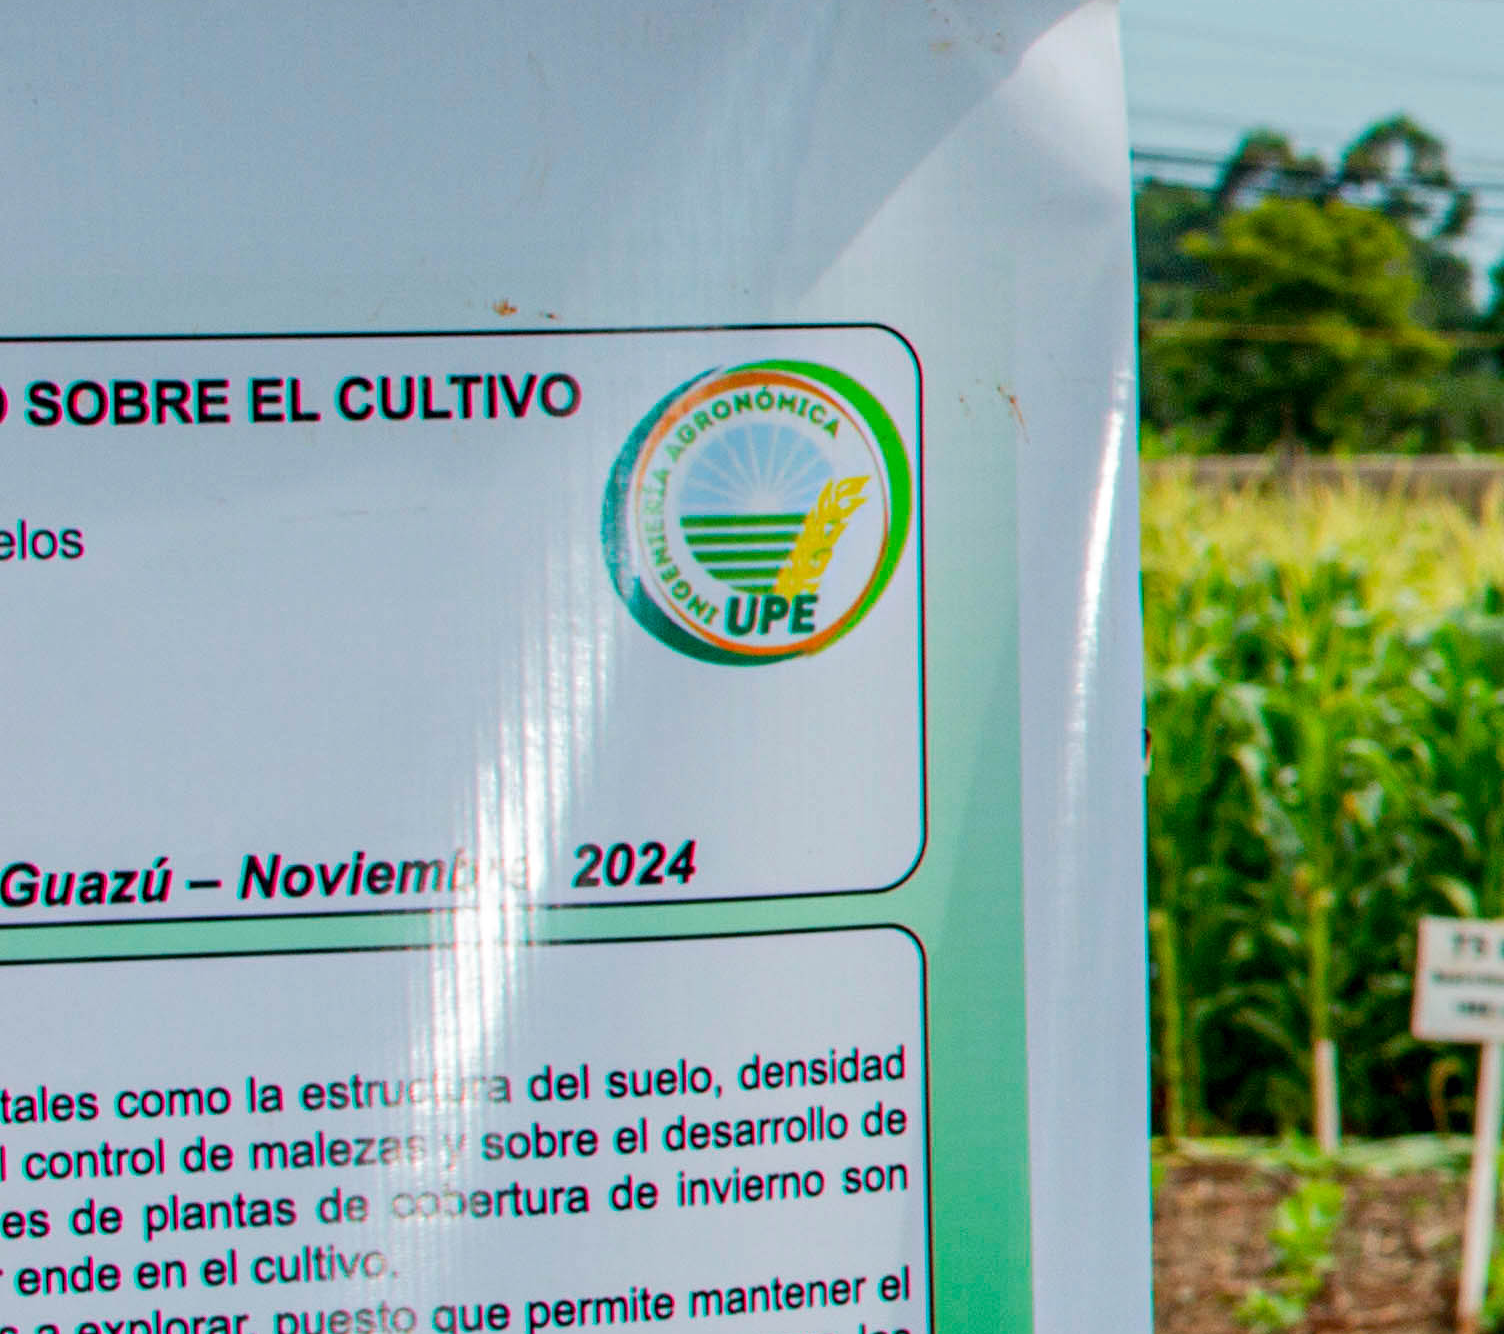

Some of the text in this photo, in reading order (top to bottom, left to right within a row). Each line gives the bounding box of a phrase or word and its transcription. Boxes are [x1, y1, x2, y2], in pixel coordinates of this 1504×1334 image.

[24, 379, 230, 427] SOBRE
[248, 377, 321, 424] EL
[334, 372, 581, 421] CULTIVO
[664, 386, 840, 463] AGRONÓMICA
[725, 593, 818, 636] UPE
[0, 856, 170, 907] Guazú
[570, 839, 696, 888] 2024
[114, 1085, 234, 1121] como
[245, 1076, 284, 1113] la
[527, 1063, 589, 1102] del
[605, 1059, 722, 1099] suelo,
[737, 1045, 904, 1091] densidad
[21, 1138, 165, 1182] control
[179, 1135, 234, 1174] de
[248, 1129, 427, 1171] malezas
[480, 1122, 598, 1161] sobre
[612, 1117, 648, 1155] el
[661, 1106, 848, 1152] desarrollo
[860, 1101, 906, 1138] de
[68, 1197, 123, 1237] de
[142, 1193, 296, 1243] plantas
[315, 1187, 367, 1224] de
[390, 1181, 591, 1221] cobertura
[608, 1174, 659, 1211] de
[677, 1166, 824, 1208] invierno
[840, 1164, 907, 1195] son
[13, 1245, 400, 1297] ende en el cultivo.
[876, 1265, 910, 1304] el
